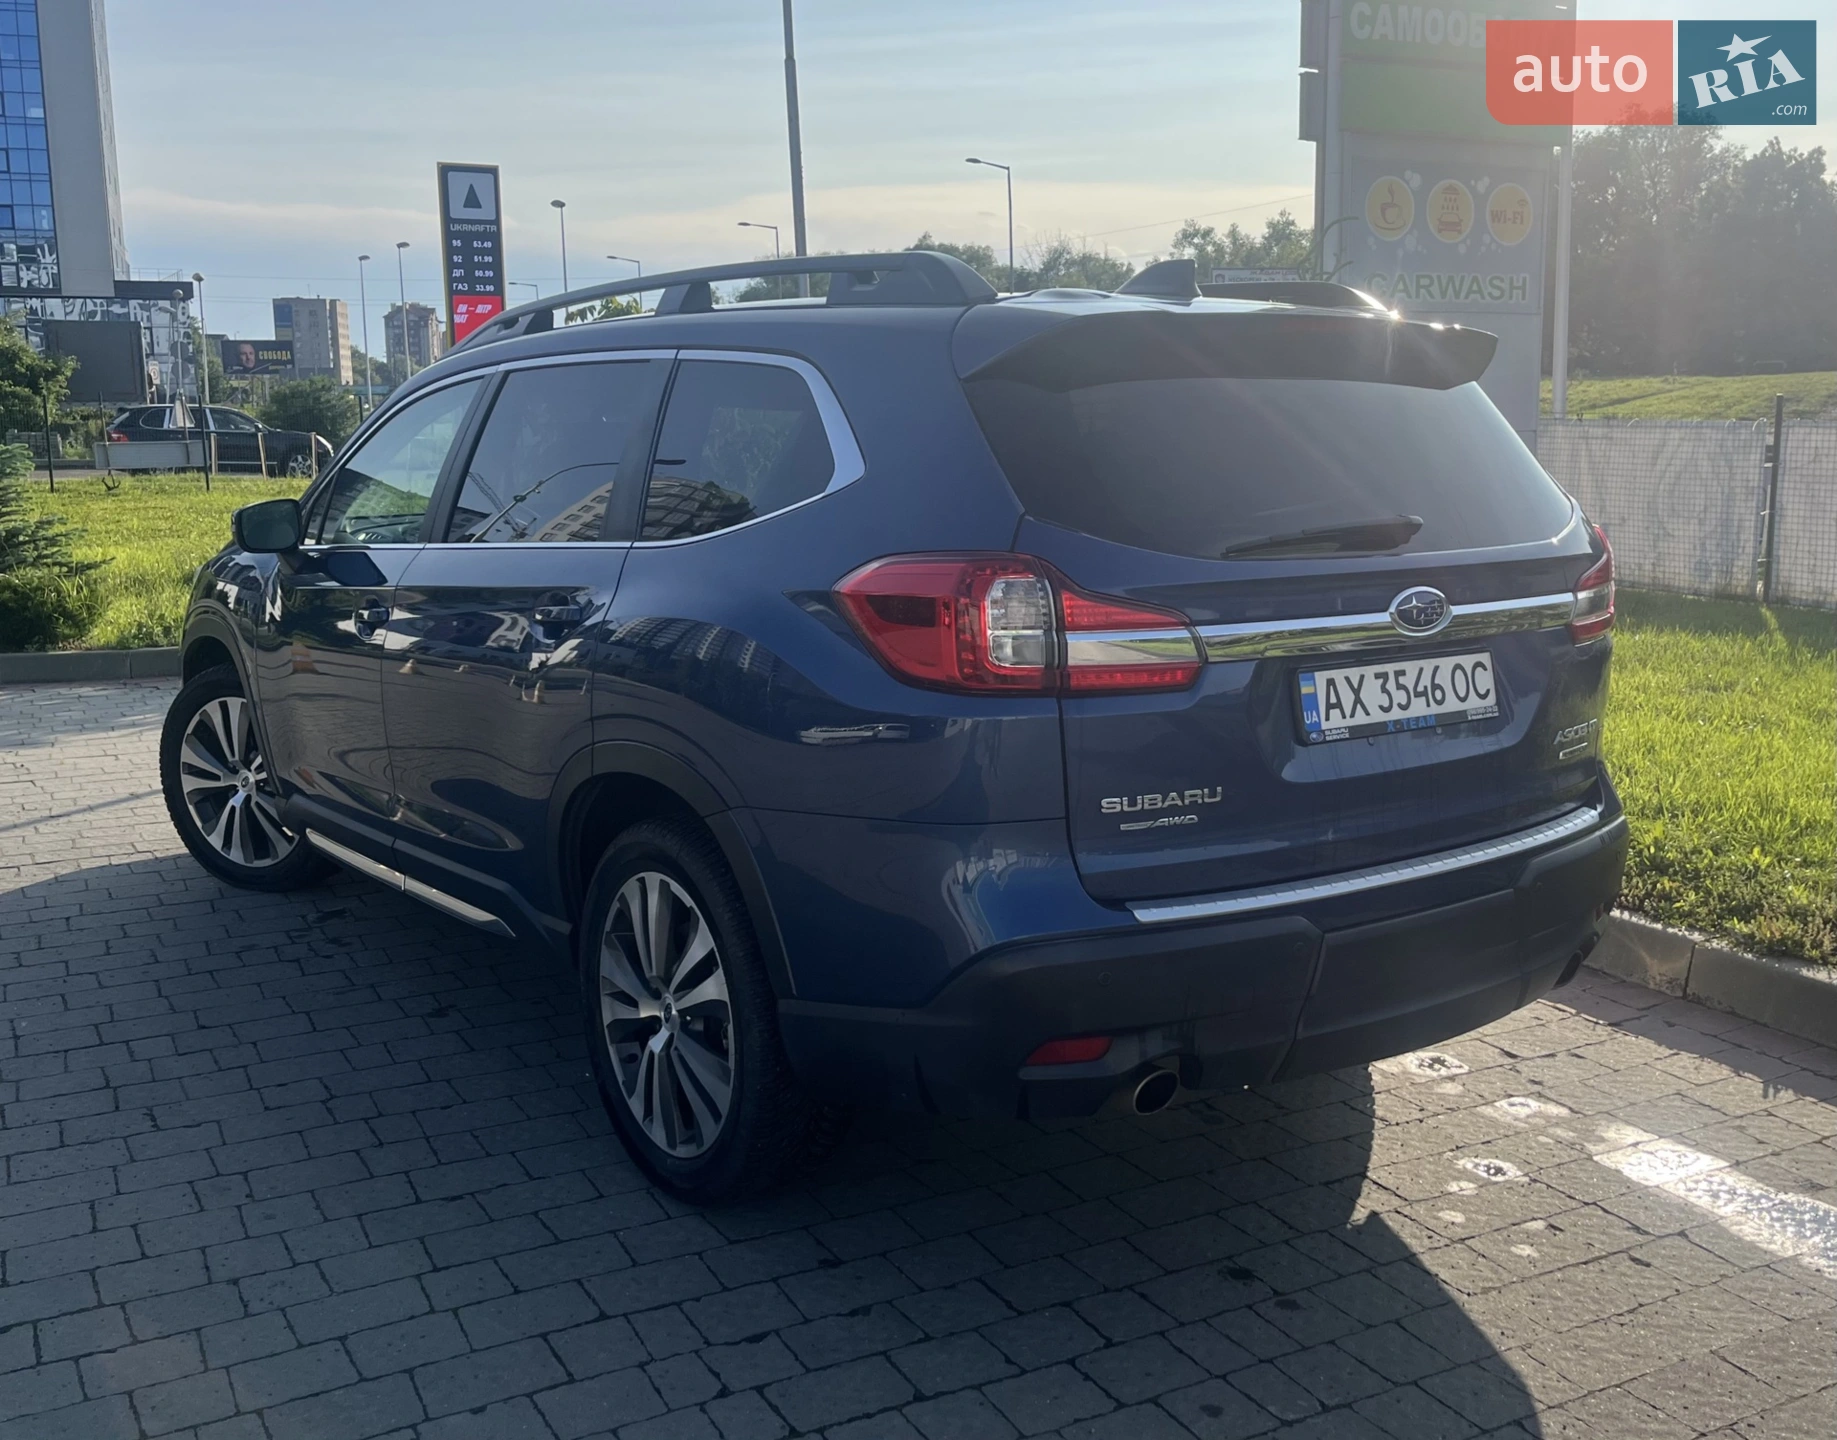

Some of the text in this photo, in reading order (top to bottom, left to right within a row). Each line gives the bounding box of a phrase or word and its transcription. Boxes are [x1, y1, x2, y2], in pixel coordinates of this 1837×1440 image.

[1490, 209, 1525, 225] Wi-Fi
[450, 223, 497, 232] UKRNAFTA
[452, 239, 492, 248] 95 53.49
[452, 255, 493, 263] 92 51.99
[452, 269, 464, 277] ДП
[452, 283, 495, 292] ГАЗ 33.99
[1366, 272, 1528, 301] CARWASH
[258, 350, 292, 361] СВОБОДА
[1324, 660, 1492, 722] AX 3546 OC
[1303, 711, 1319, 725] UA
[1324, 727, 1349, 736] SUBARU
[1325, 733, 1350, 741] SERVICE
[1100, 786, 1222, 813] SUBARU
[1151, 815, 1199, 828] AWD
